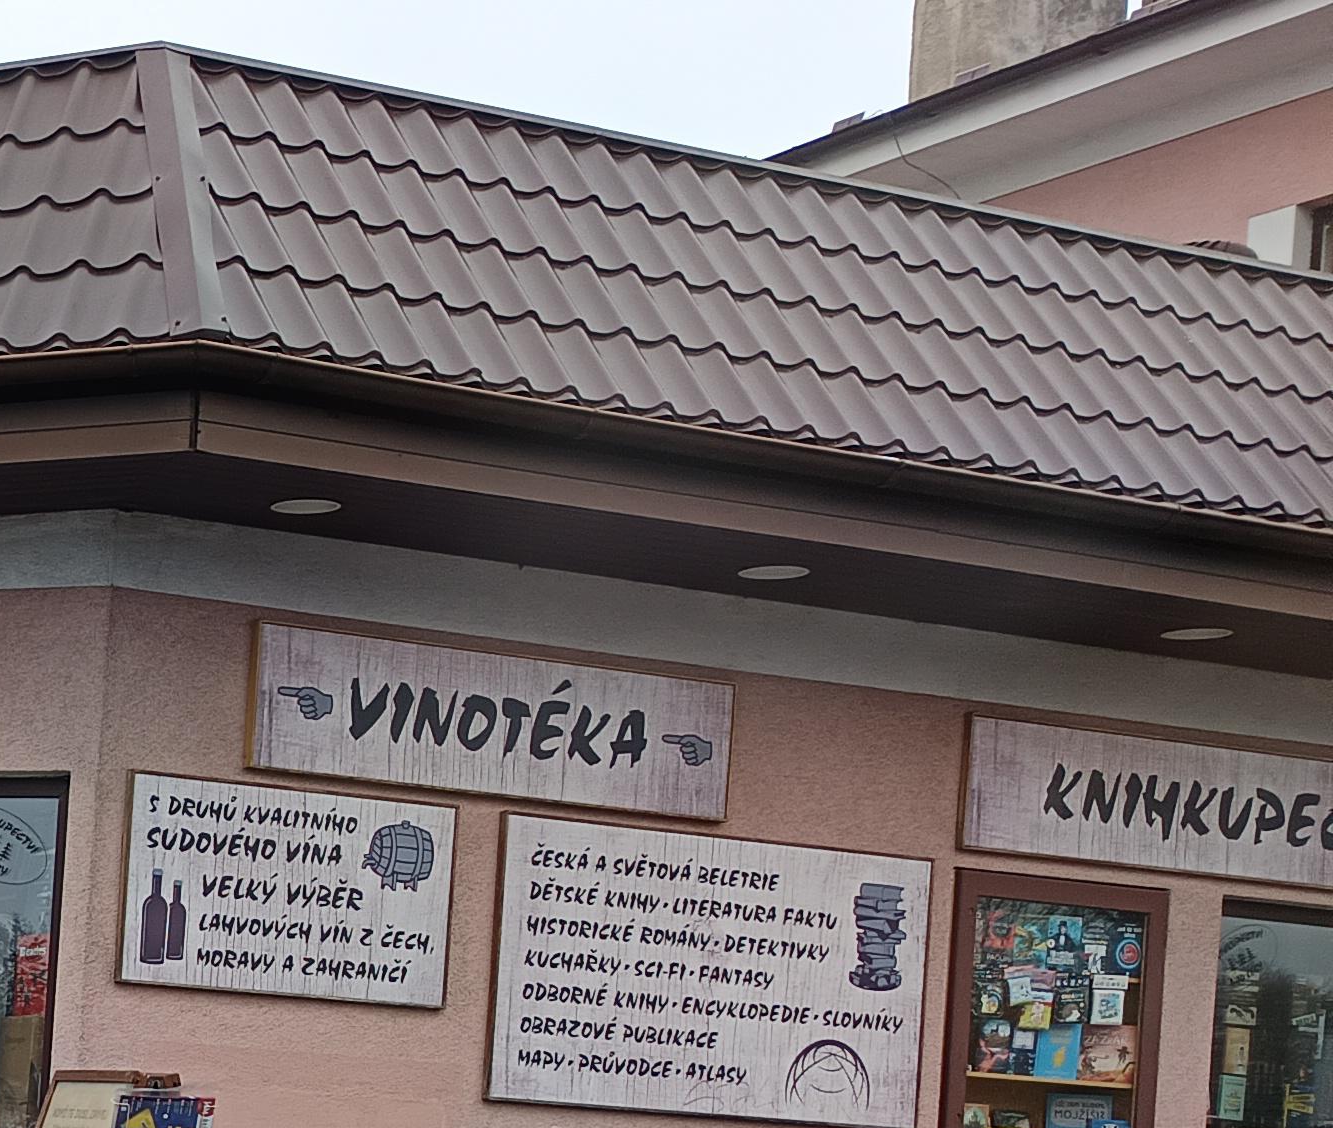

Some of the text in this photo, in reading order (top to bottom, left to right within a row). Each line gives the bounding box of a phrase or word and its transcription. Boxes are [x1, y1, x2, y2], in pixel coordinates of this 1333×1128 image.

[349, 678, 647, 769] VINOTÉKA
[168, 796, 238, 823] DRUHŮ
[244, 806, 358, 835] KVALITNÍHO
[147, 826, 343, 866] SUDOVÉHO VÍNA
[531, 842, 780, 891] ČESKÁ A SVĚTOVÁ BELETRIE
[202, 873, 364, 911] VELKÝ VÝBĚR
[530, 877, 838, 930] DĚTSKÉ KNIHY LITERATURA FAKTU
[199, 913, 434, 955] LAHVOVÝCH VÍN Z ČECH,
[527, 915, 830, 963] HISTORICKÉ ROMÁNY DETEKTIVKY
[196, 948, 412, 984] MORAVY A ZAHRANIČÍ
[524, 949, 774, 990] KUCHAŘKY SCI-FI FANTASY
[522, 983, 903, 1034] ODBORNÉ KNIHY ENCYKLOPEDIE SLOVNÍKY
[520, 1016, 719, 1048] OBRAZOVÉ PUBLIKACE
[517, 1049, 747, 1086] MAPY PRŮVODCE ATLASY
